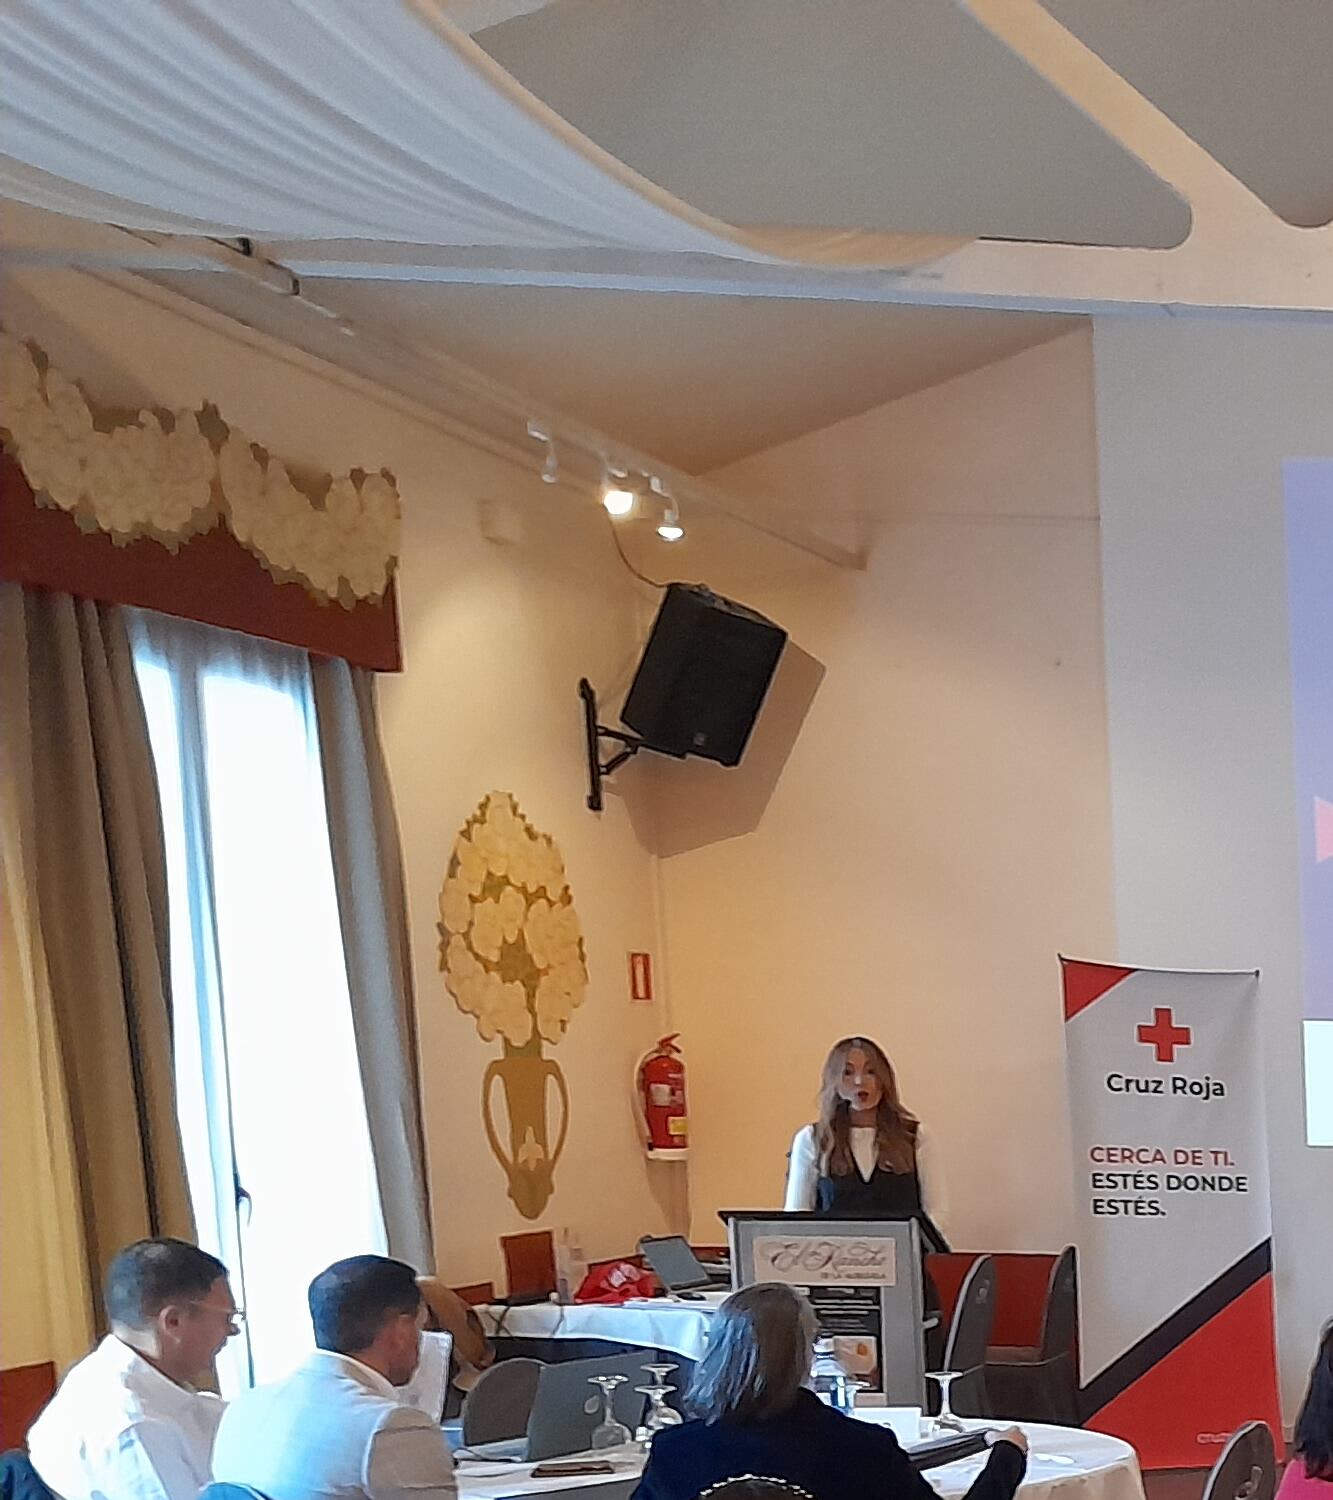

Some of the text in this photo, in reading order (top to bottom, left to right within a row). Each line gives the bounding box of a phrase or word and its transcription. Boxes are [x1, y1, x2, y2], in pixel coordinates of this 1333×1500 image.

[1106, 1073, 1226, 1100] Cruz Roja
[1090, 1147, 1235, 1167] CERCA DE TI.
[1091, 1170, 1249, 1192] ESTÉS DONDE
[1092, 1196, 1167, 1217] ESTÉS.
